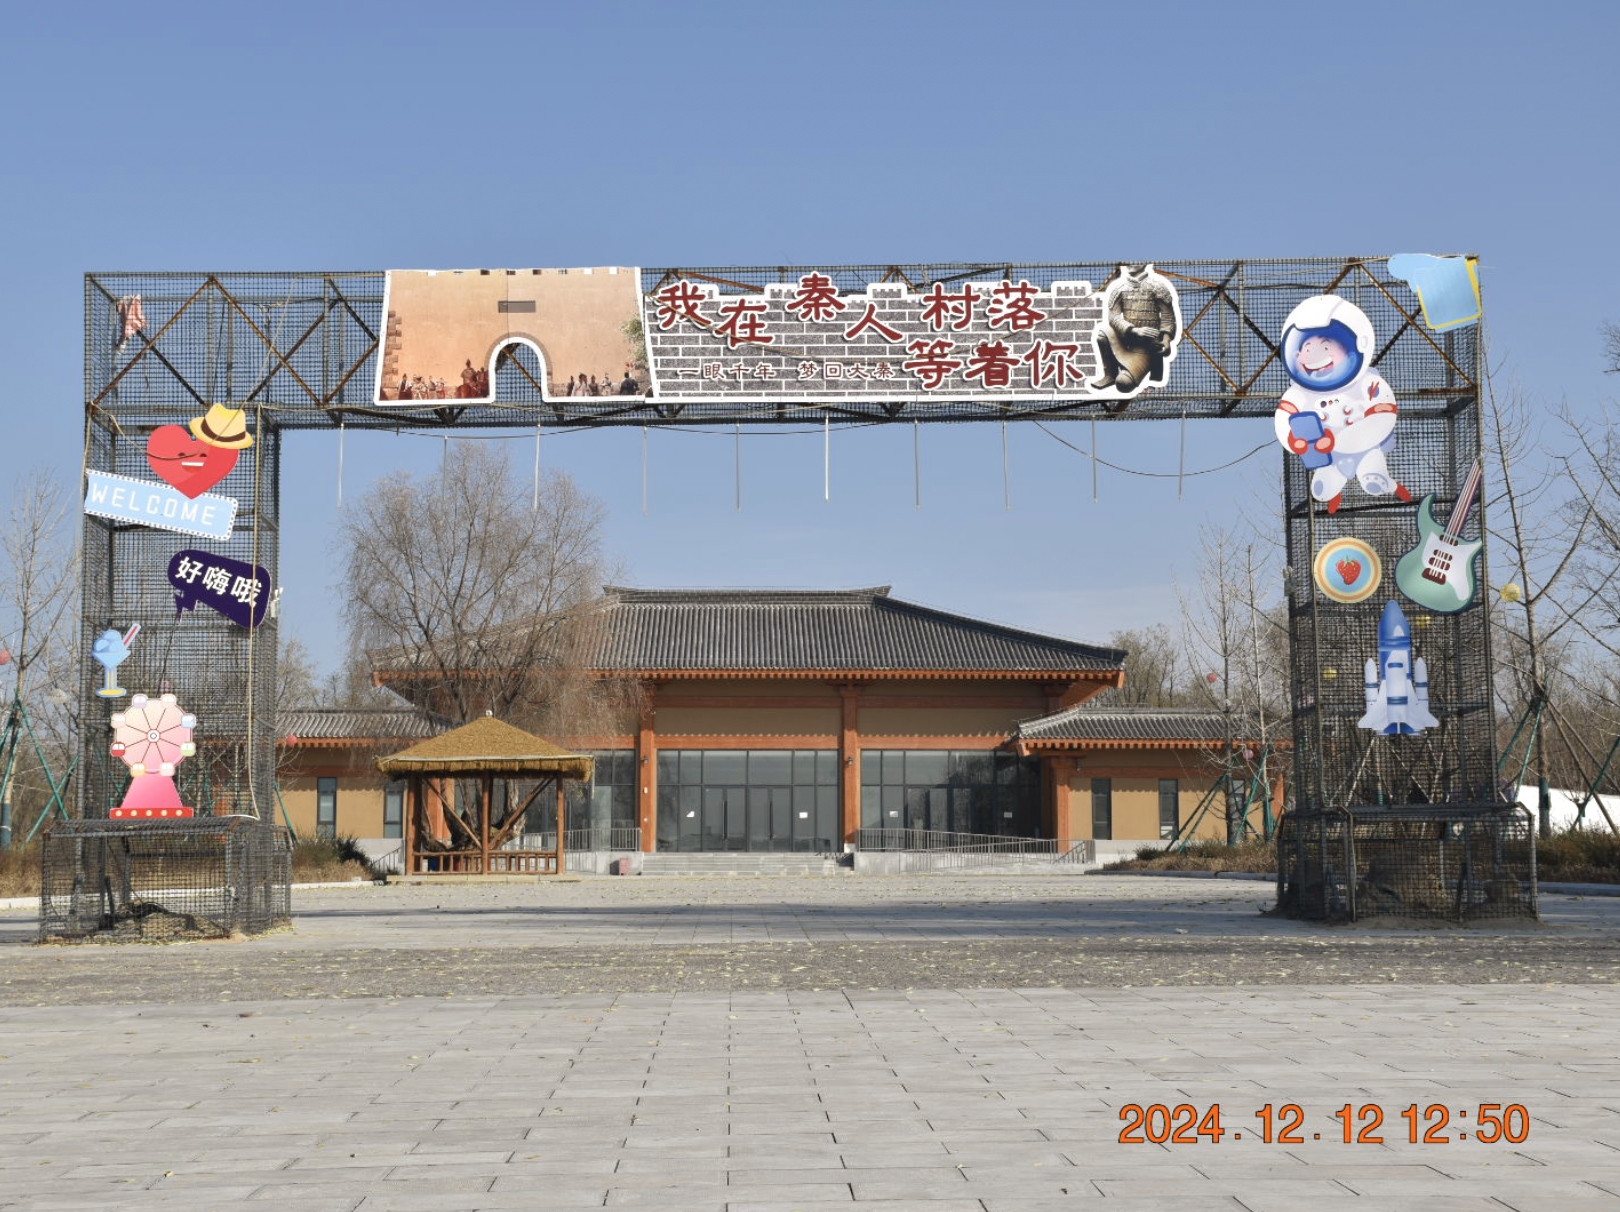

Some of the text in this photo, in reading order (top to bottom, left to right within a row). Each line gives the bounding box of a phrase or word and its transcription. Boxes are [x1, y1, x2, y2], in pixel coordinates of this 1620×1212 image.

[678, 361, 894, 379] 一眼千年 梦回大秦
[904, 339, 1084, 389] 等着你
[91, 482, 217, 526] WELCOME
[175, 556, 262, 608] 好嗨哦
